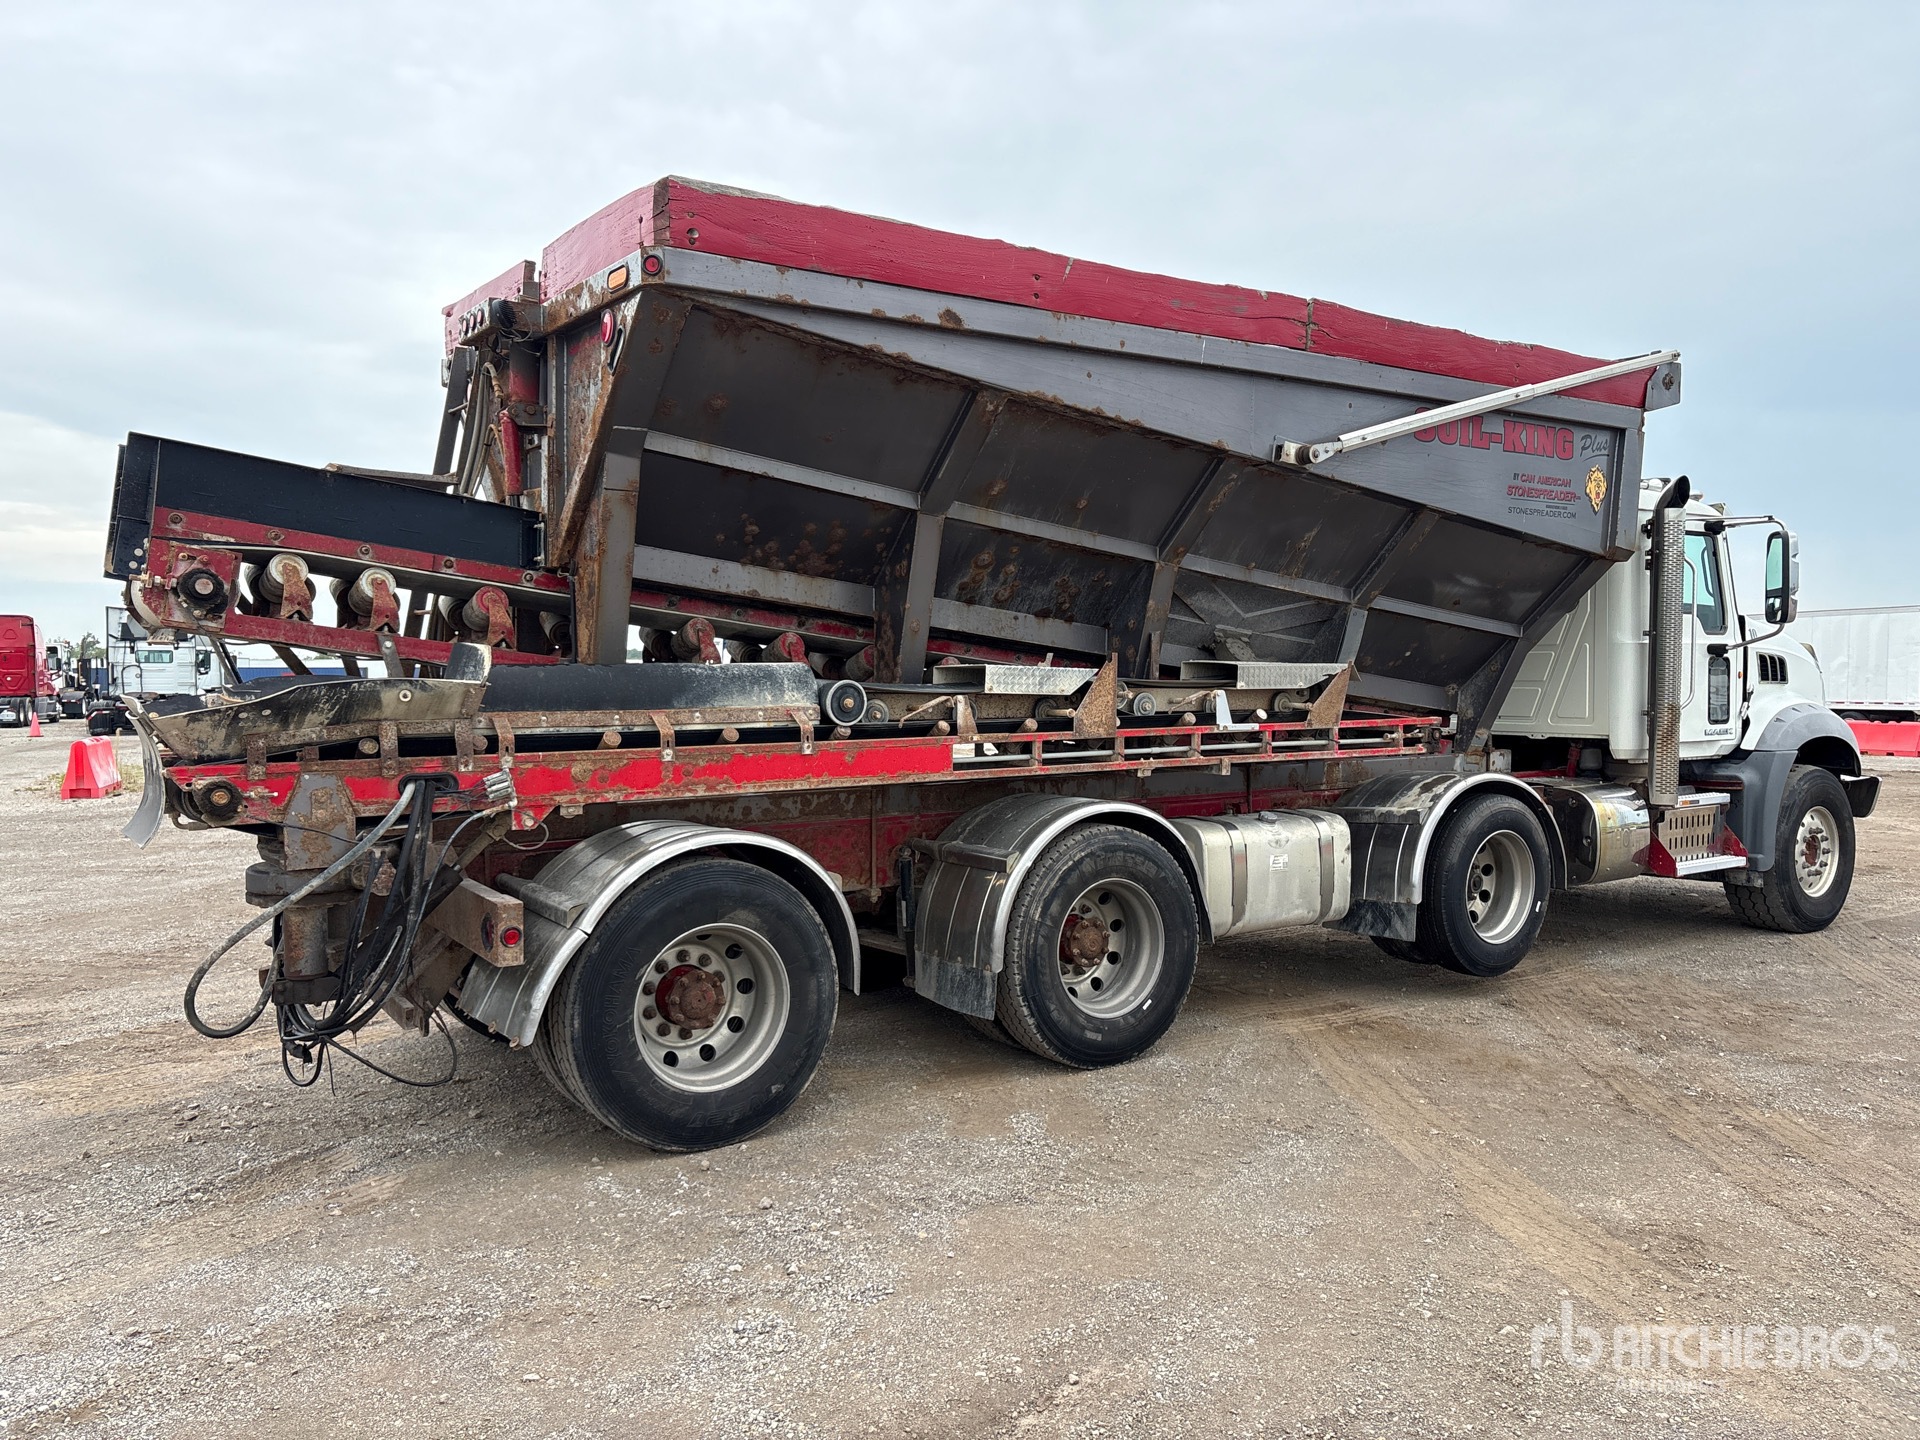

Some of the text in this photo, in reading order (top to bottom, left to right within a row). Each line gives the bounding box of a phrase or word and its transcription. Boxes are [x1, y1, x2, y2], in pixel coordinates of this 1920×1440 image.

[1579, 434, 1610, 458] Plus
[1513, 472, 1572, 488] BY CAN AMERICAN
[1507, 506, 1577, 520] STONESPREADER.COM
[1704, 727, 1734, 737] MACK
[601, 945, 642, 1067] YOKOHAMA
